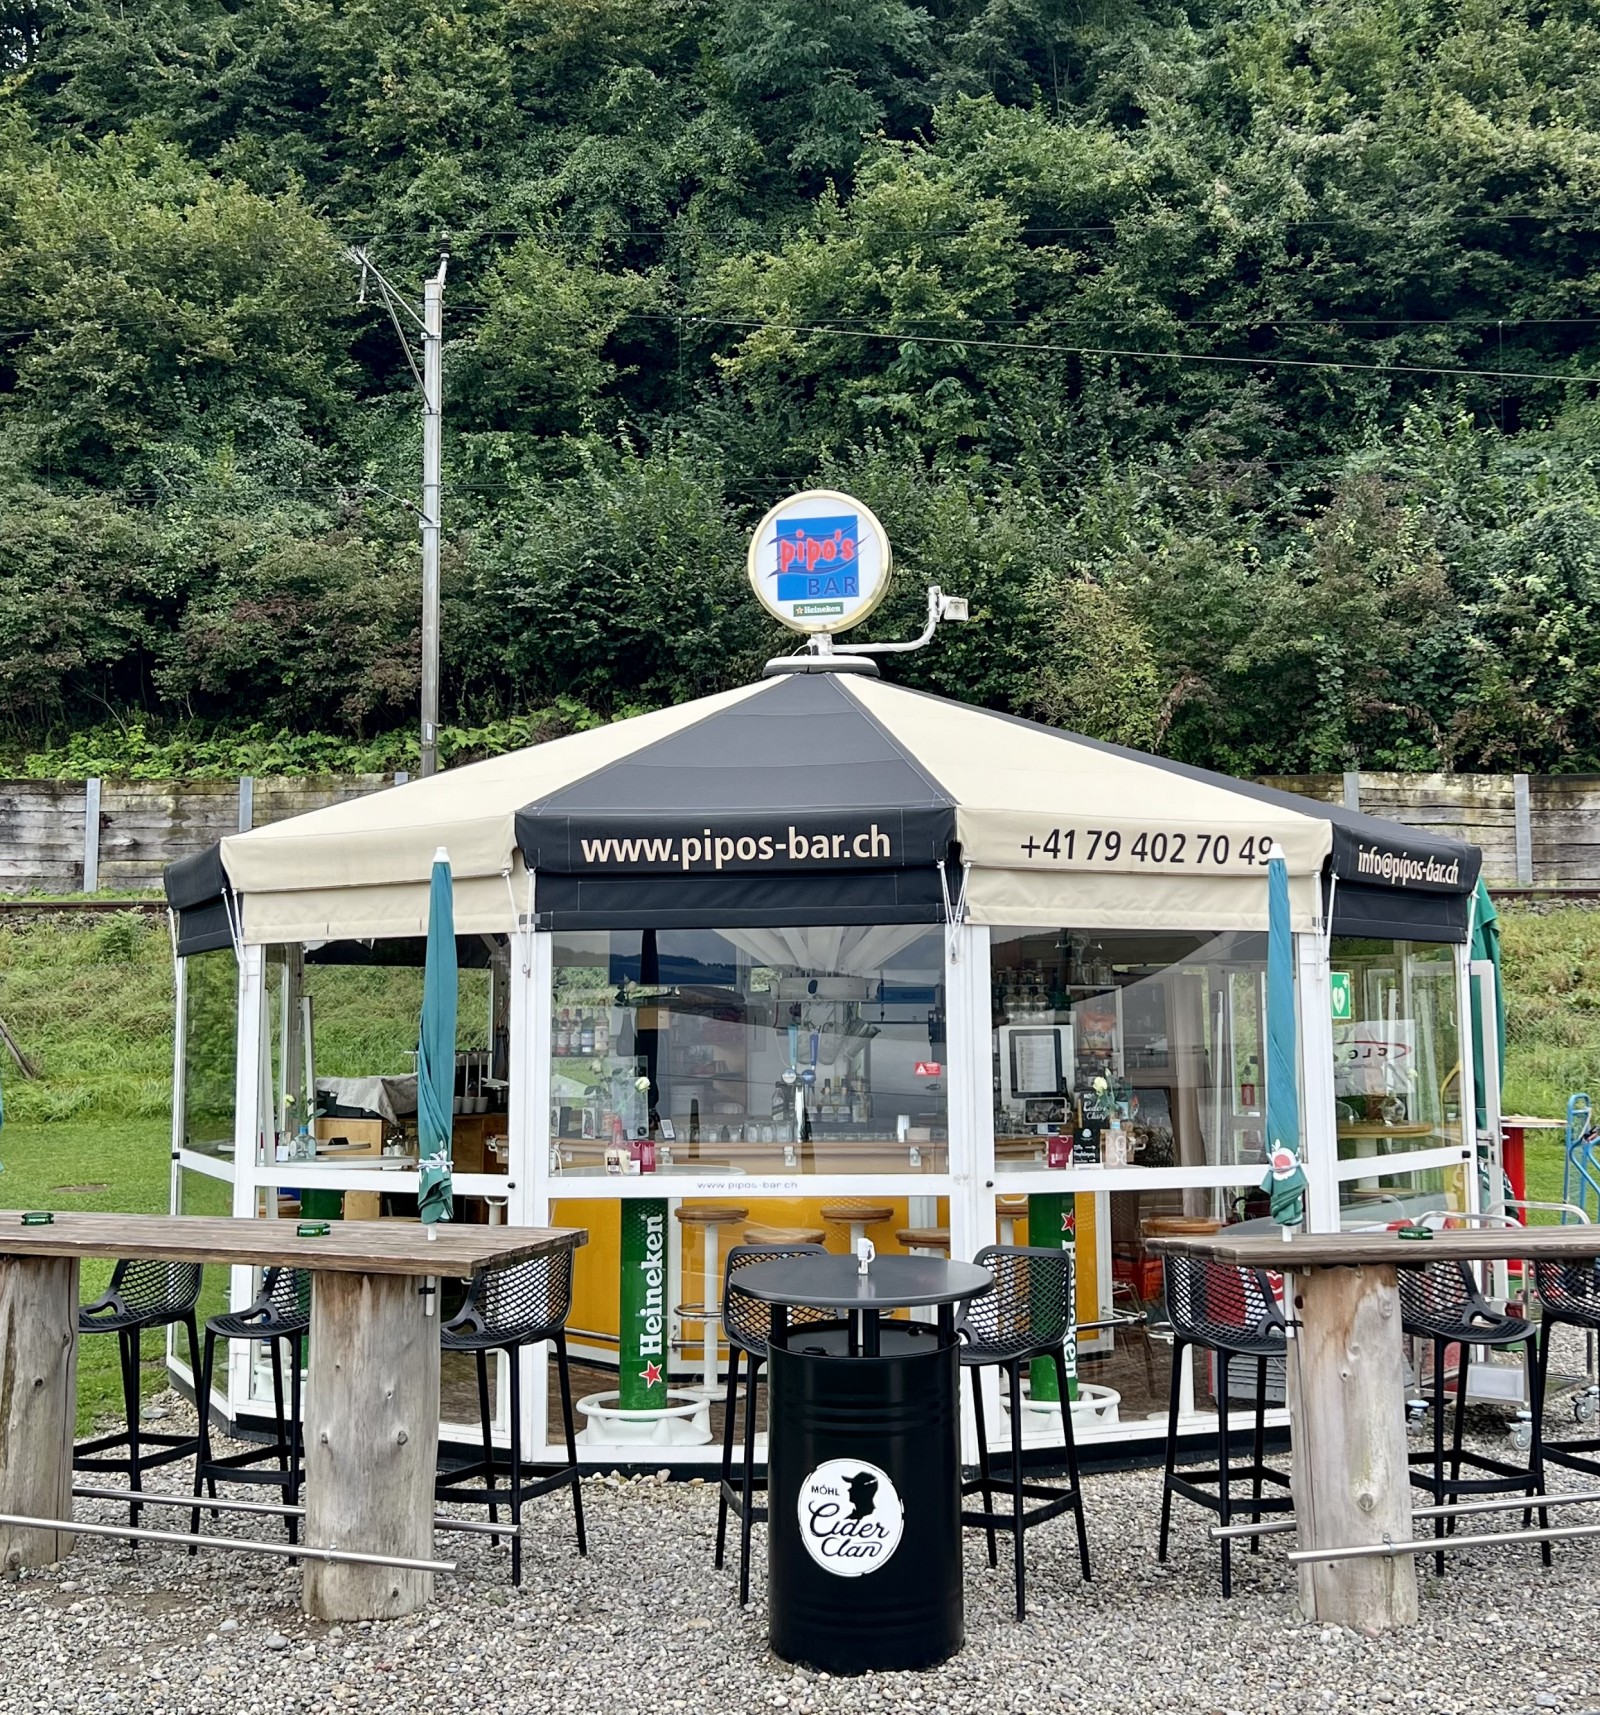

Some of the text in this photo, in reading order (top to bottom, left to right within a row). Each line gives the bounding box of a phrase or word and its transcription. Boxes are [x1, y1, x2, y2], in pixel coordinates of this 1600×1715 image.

[779, 530, 855, 573] pipo's
[807, 577, 857, 595] BAR
[804, 604, 841, 614] Heineken
[580, 824, 891, 870] www.pipos-bar.ch
[1020, 828, 1274, 866] +41 79 402 70 49
[1358, 844, 1459, 886] info@pipos-bar.ch
[639, 1213, 663, 1357] Heineken
[808, 1500, 890, 1538] Cider
[821, 1537, 883, 1558] Clan
